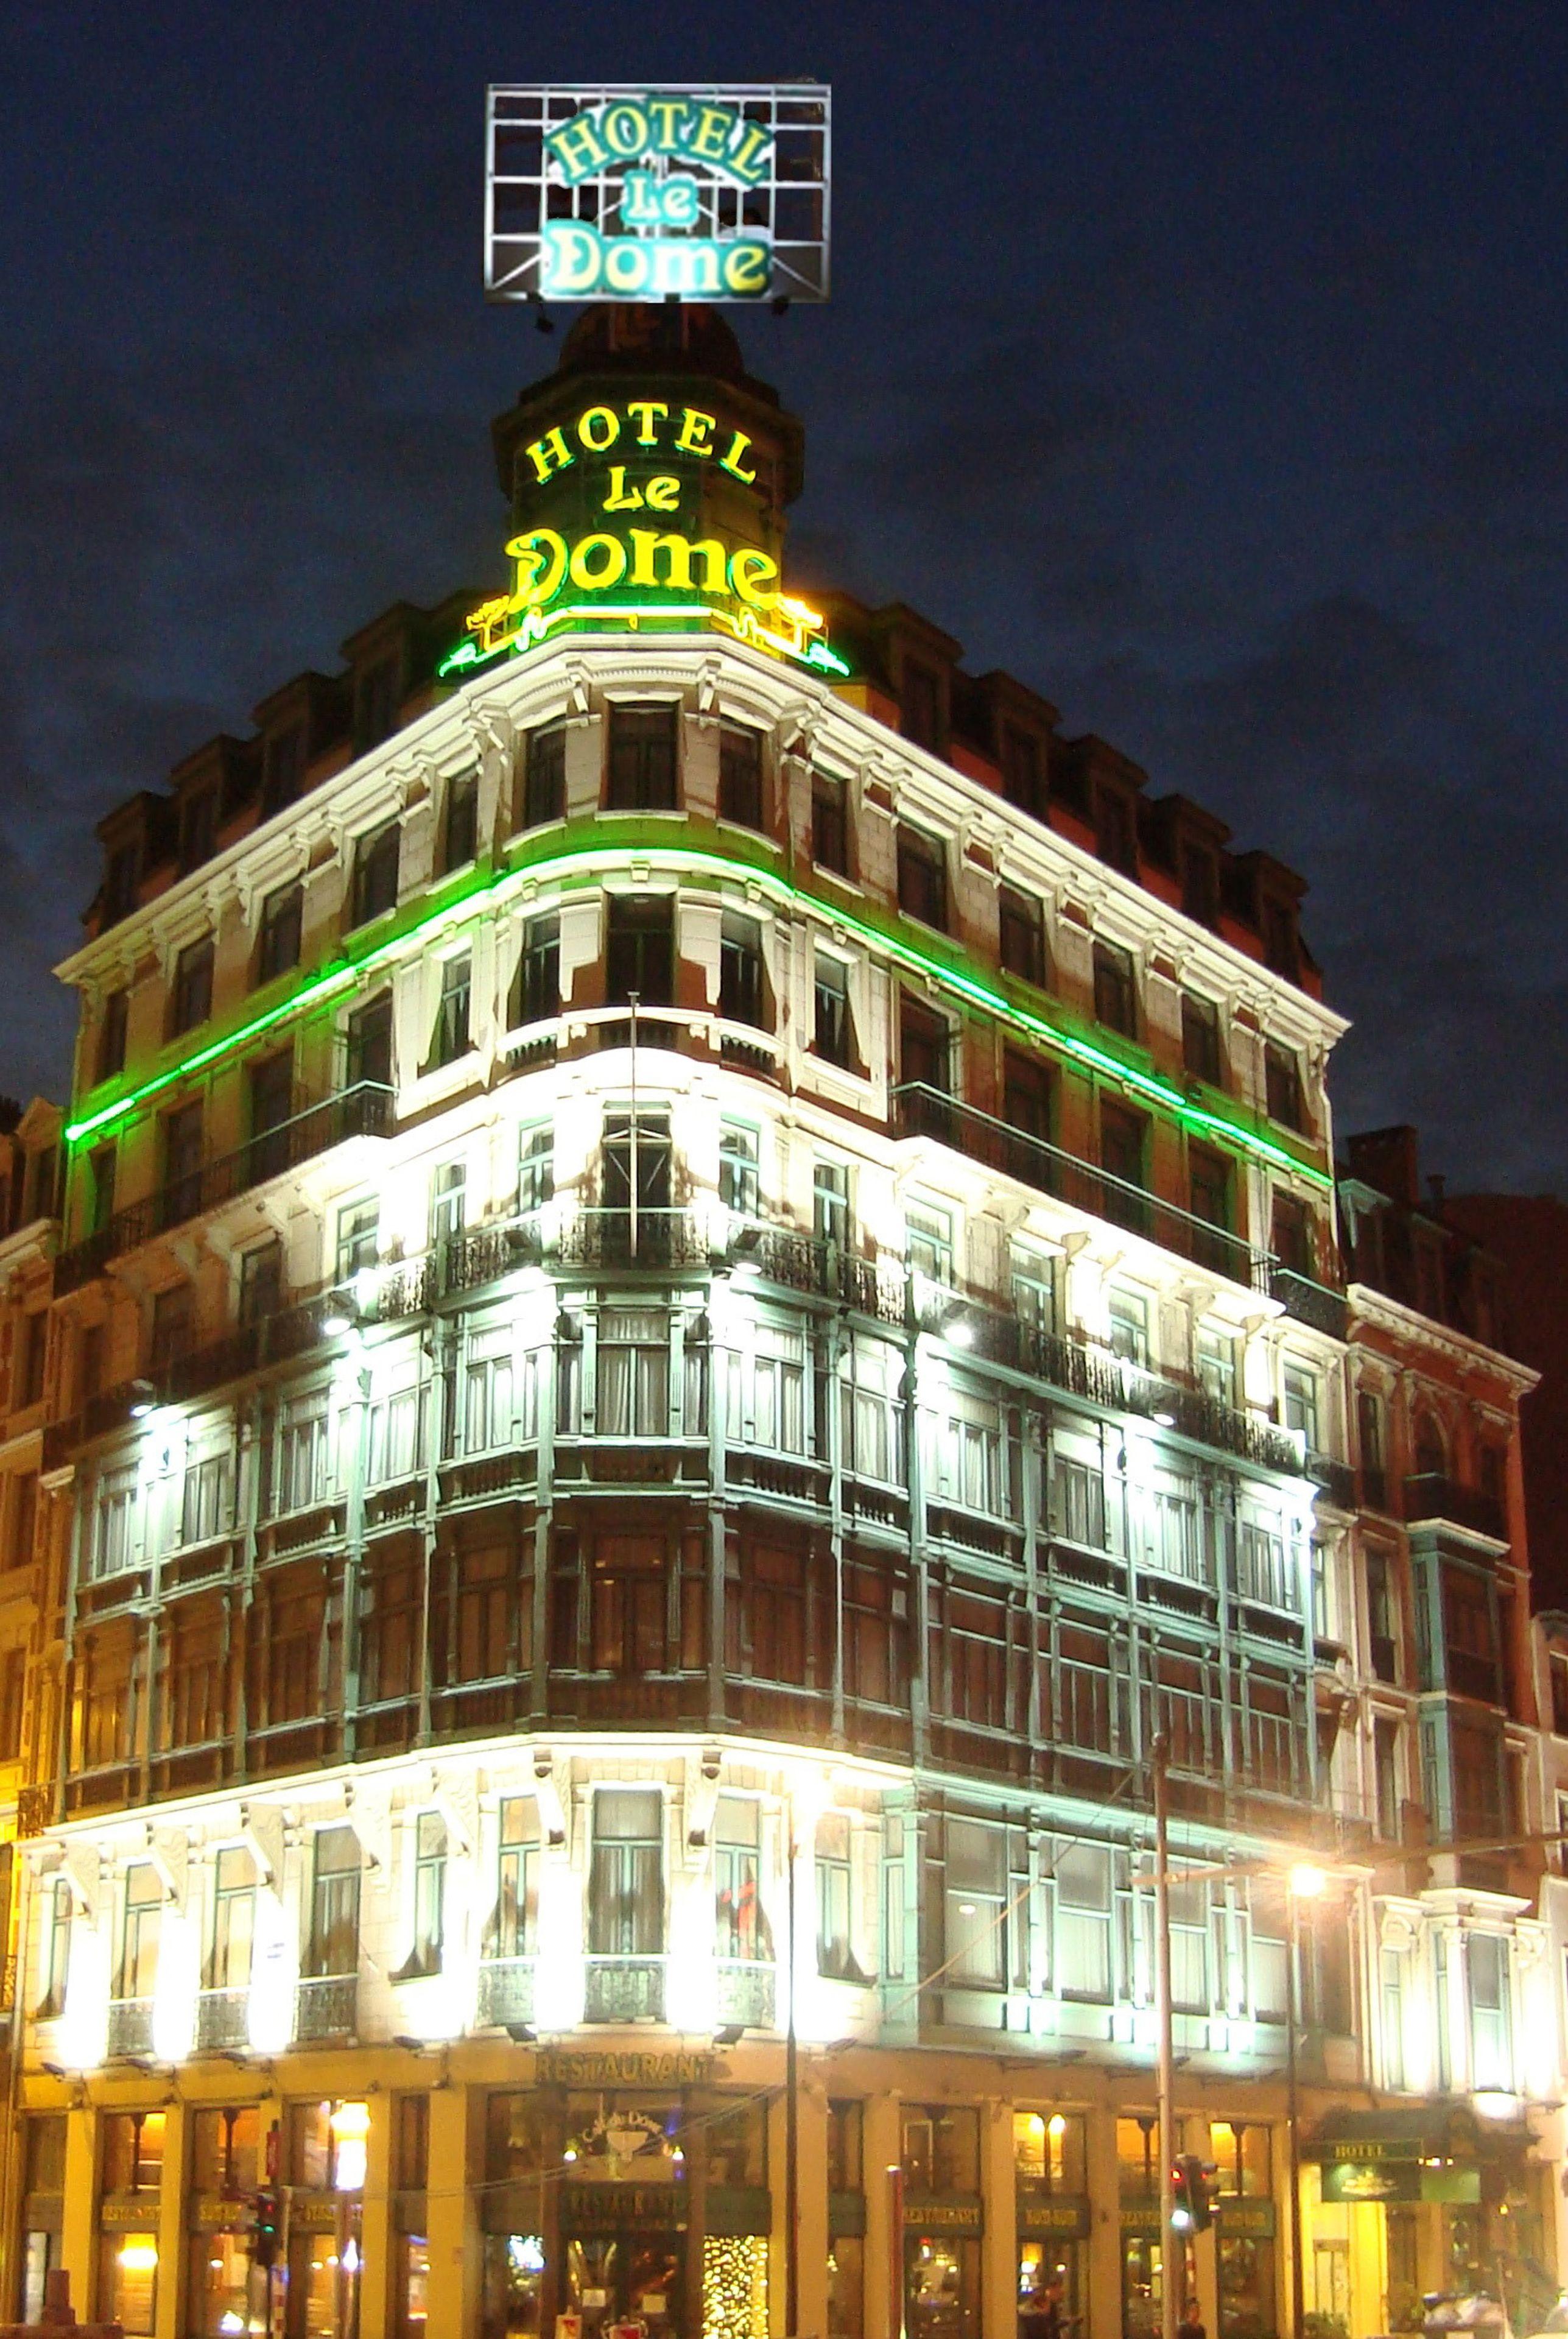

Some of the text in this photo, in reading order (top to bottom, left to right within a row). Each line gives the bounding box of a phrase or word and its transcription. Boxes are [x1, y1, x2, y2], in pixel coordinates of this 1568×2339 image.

[549, 102, 767, 179] HOTEL
[627, 177, 692, 218] Le
[548, 228, 767, 292] Dome
[526, 401, 756, 484] HOTEL
[603, 466, 681, 512] Le
[505, 528, 778, 613] Dome
[536, 2052, 715, 2081] RESTAURANT
[1335, 2145, 1385, 2158] HOTEL
